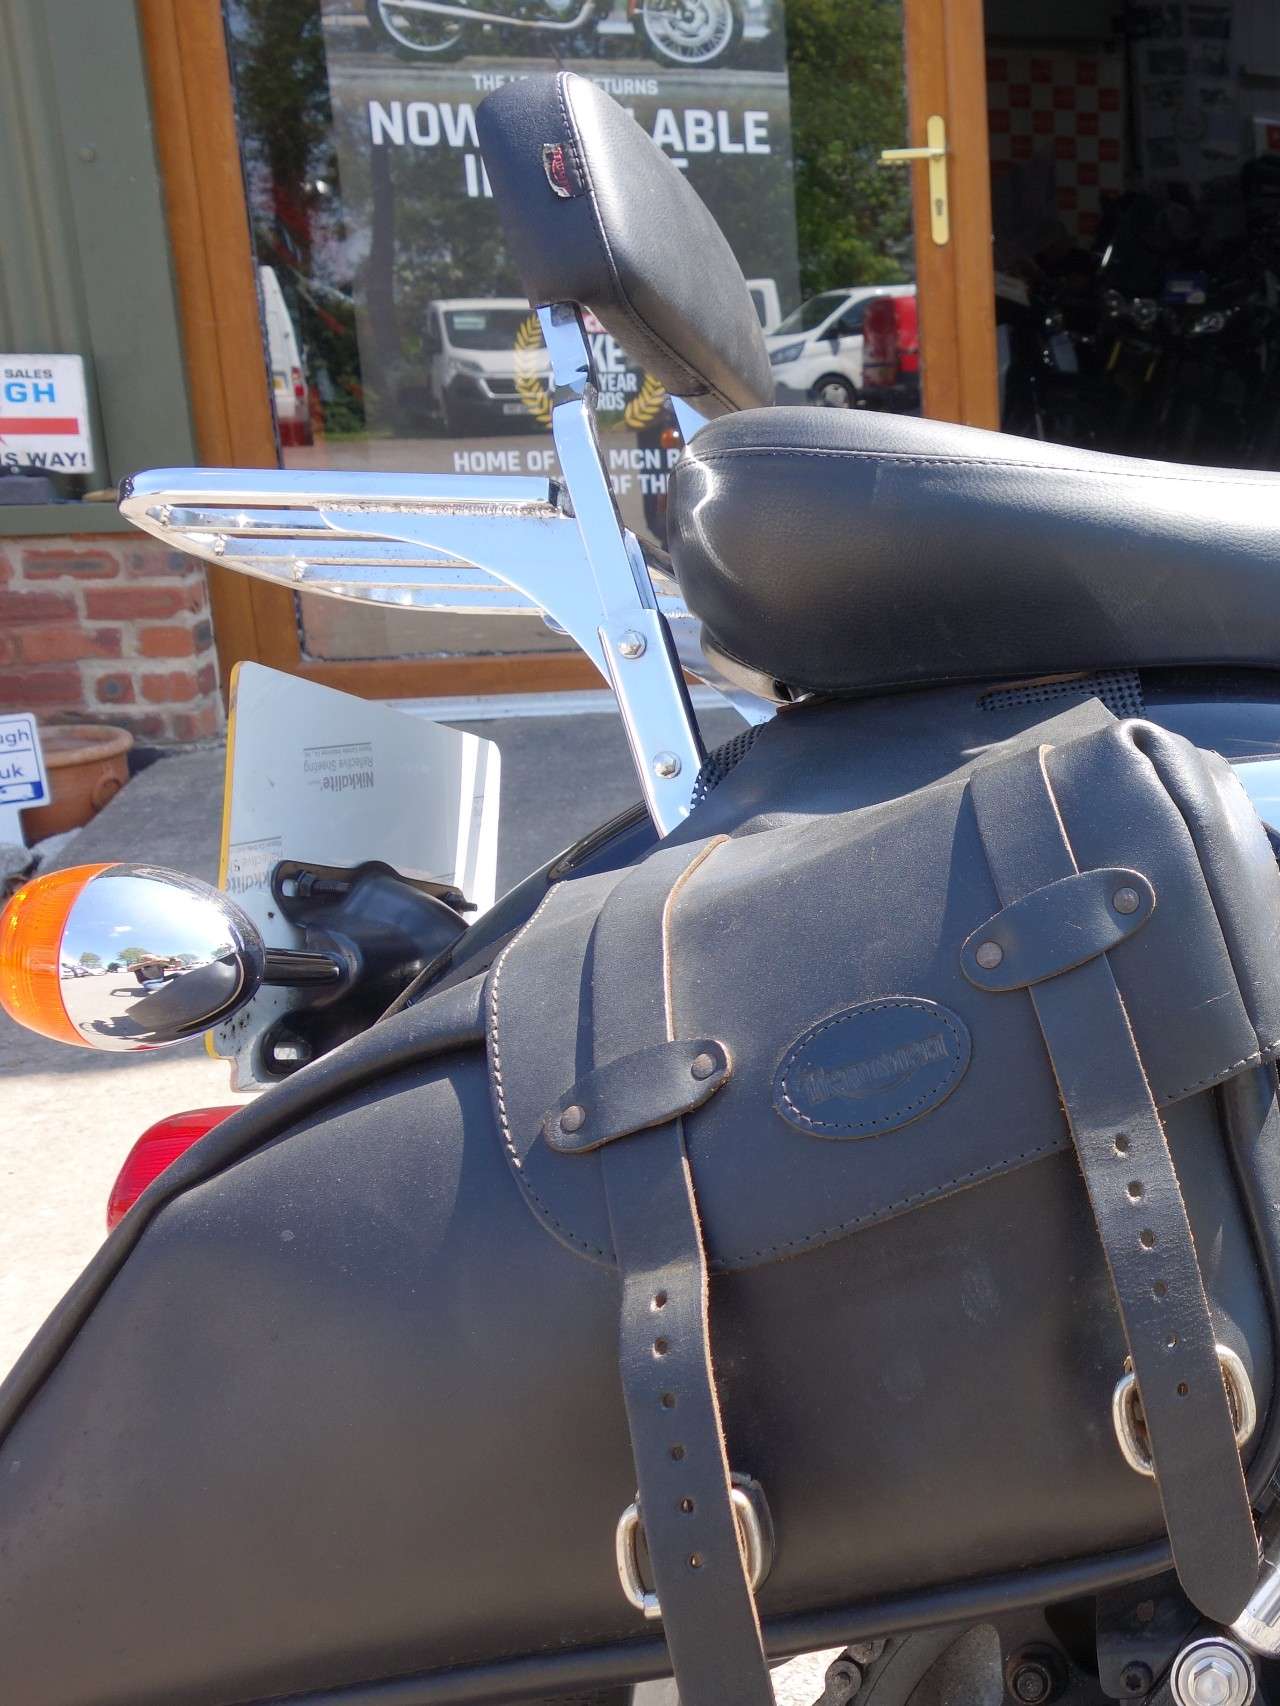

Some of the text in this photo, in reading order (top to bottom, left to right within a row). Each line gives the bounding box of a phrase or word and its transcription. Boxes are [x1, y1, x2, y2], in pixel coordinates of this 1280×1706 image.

[369, 100, 480, 148] NOW
[4, 369, 53, 379] SALES
[598, 373, 637, 392] YEAR
[26, 452, 87, 467] WAY!
[454, 450, 520, 472] HOME
[527, 450, 555, 471] OF
[609, 449, 661, 470] MCN
